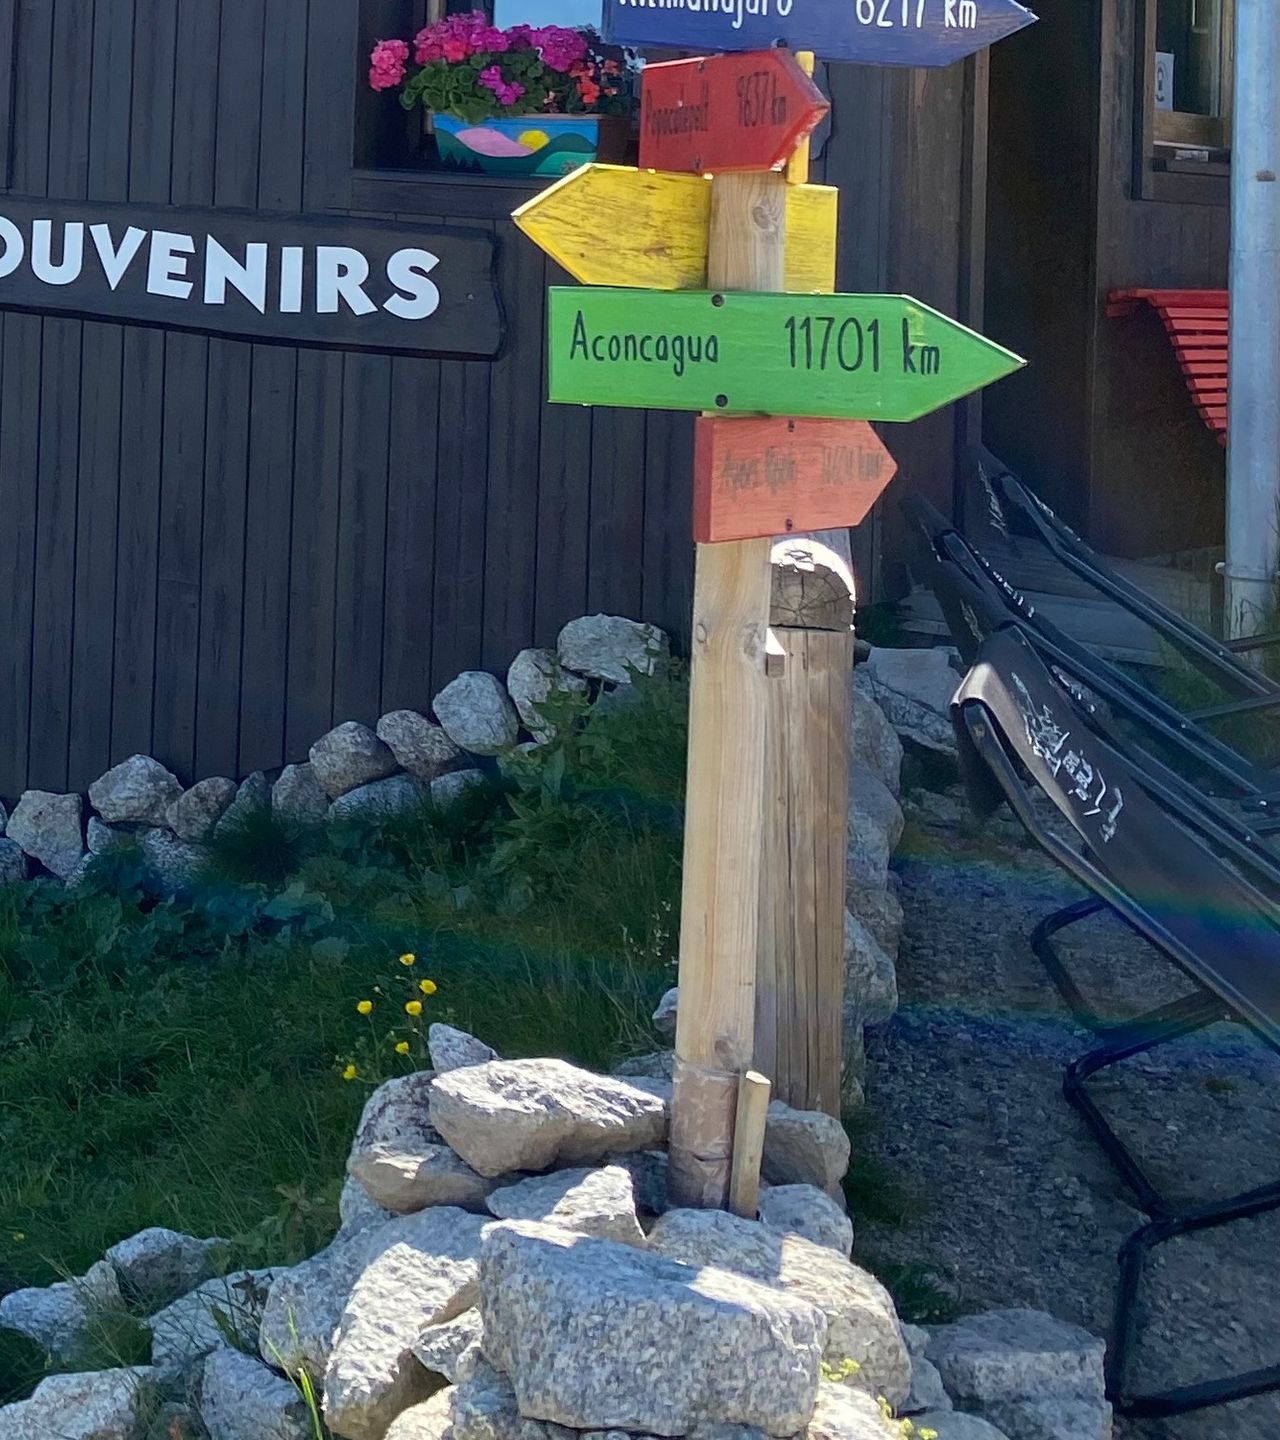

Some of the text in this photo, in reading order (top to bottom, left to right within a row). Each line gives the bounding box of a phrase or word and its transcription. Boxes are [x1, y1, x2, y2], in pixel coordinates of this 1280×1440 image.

[570, 309, 940, 377] Aconcagua 11701 km
